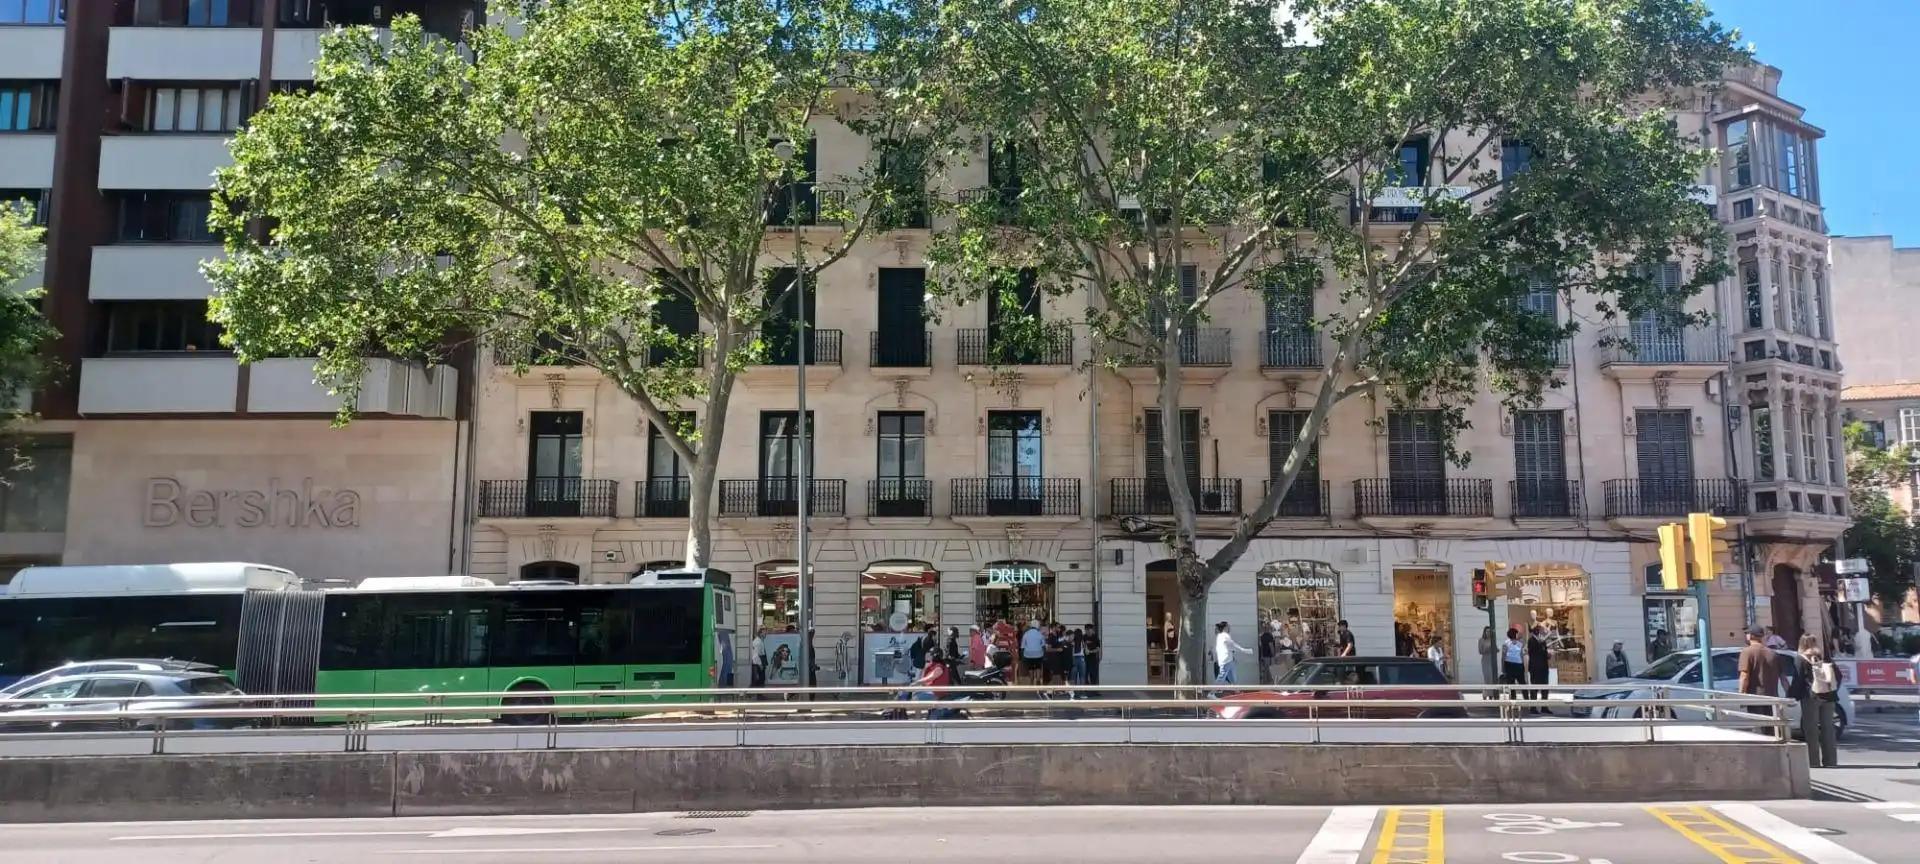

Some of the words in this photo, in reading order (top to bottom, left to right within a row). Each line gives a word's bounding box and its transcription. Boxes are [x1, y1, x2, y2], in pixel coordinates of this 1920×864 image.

[142, 477, 360, 528] Bershka
[989, 568, 1041, 584] DRUNI
[1262, 577, 1334, 587] CALZEDONIA
